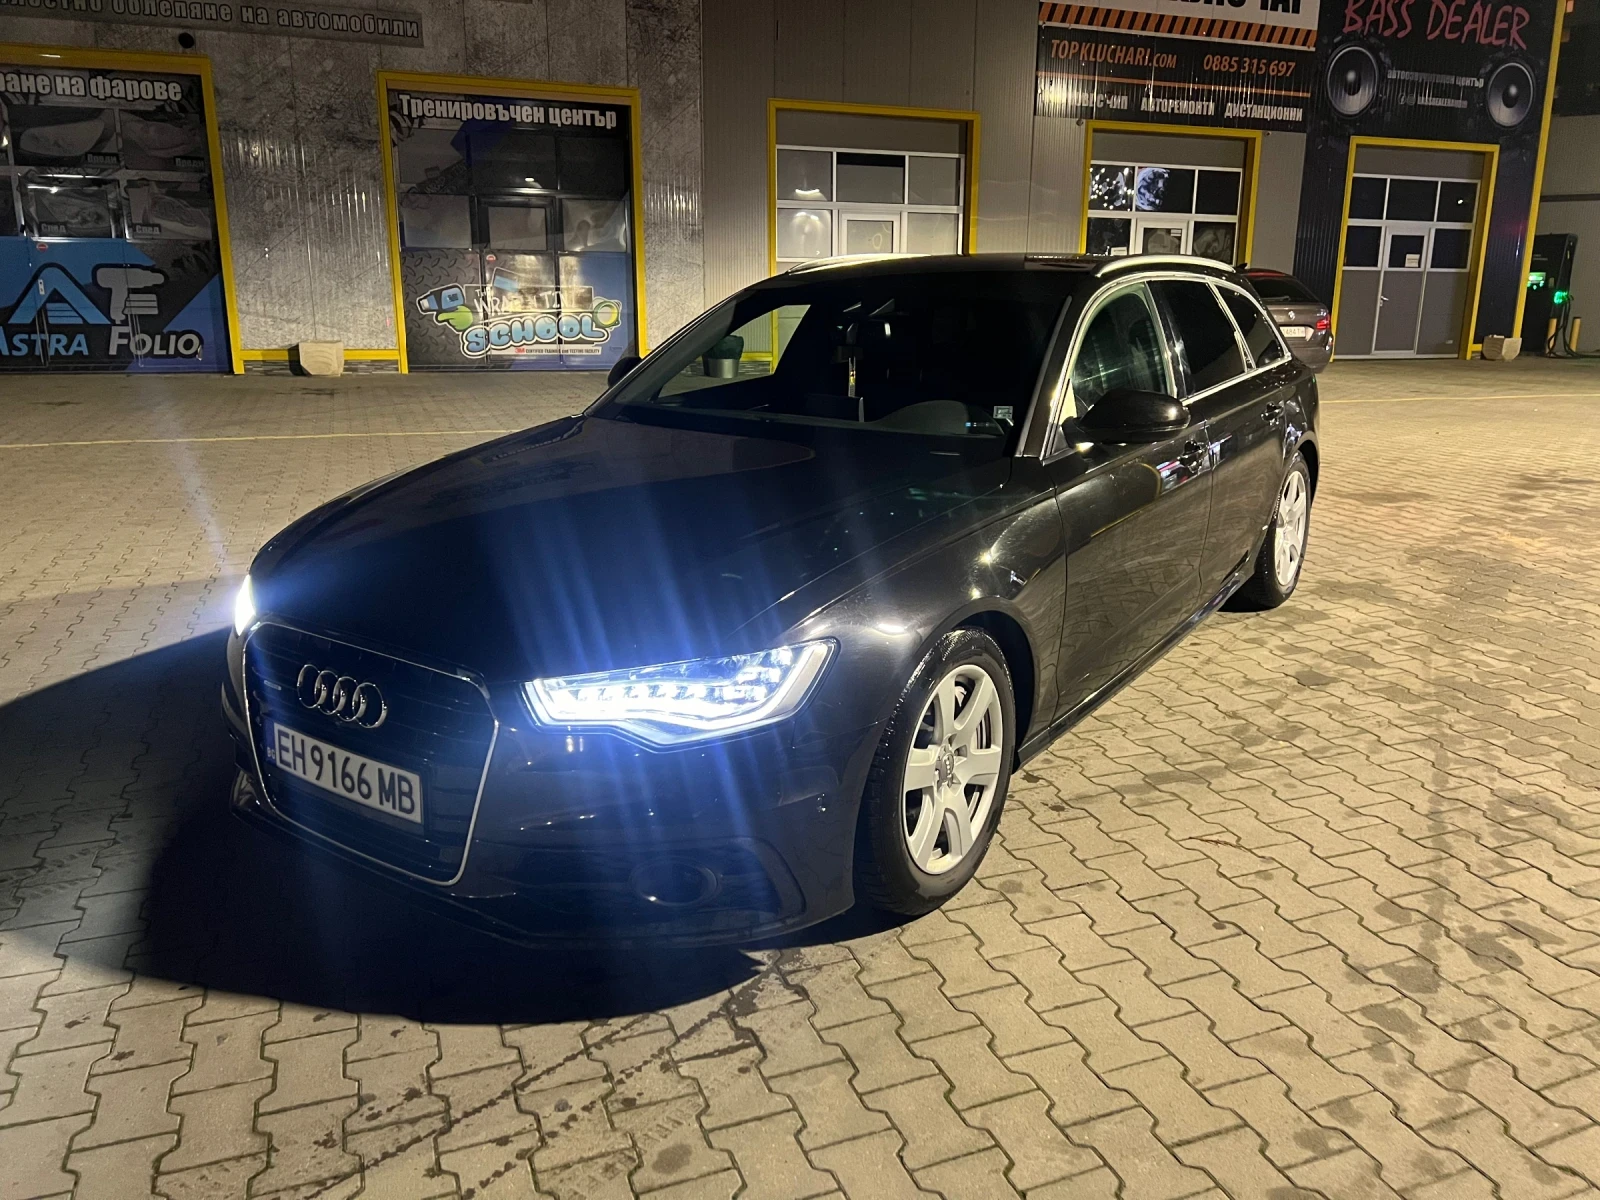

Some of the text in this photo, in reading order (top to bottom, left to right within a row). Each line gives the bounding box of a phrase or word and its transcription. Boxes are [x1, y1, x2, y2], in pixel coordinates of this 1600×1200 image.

[112, 0, 233, 21] облепяне
[241, 5, 269, 25] на
[277, 9, 419, 38] автомобили
[1343, 0, 1530, 50] BASS DEALER
[1203, 54, 1238, 73] 0885
[1240, 58, 1266, 75] 315
[1269, 60, 1296, 77] 697
[55, 75, 86, 97] на
[89, 75, 183, 101] фарове
[399, 94, 617, 129] Тренировъчен център
[1140, 97, 1215, 117] АВТОРЕМОНТИ
[1224, 102, 1303, 122] ДИСТАНЦИОННИ
[109, 326, 201, 356] FOLIO
[462, 312, 608, 356] SCHOOL
[310, 744, 373, 801] 9166
